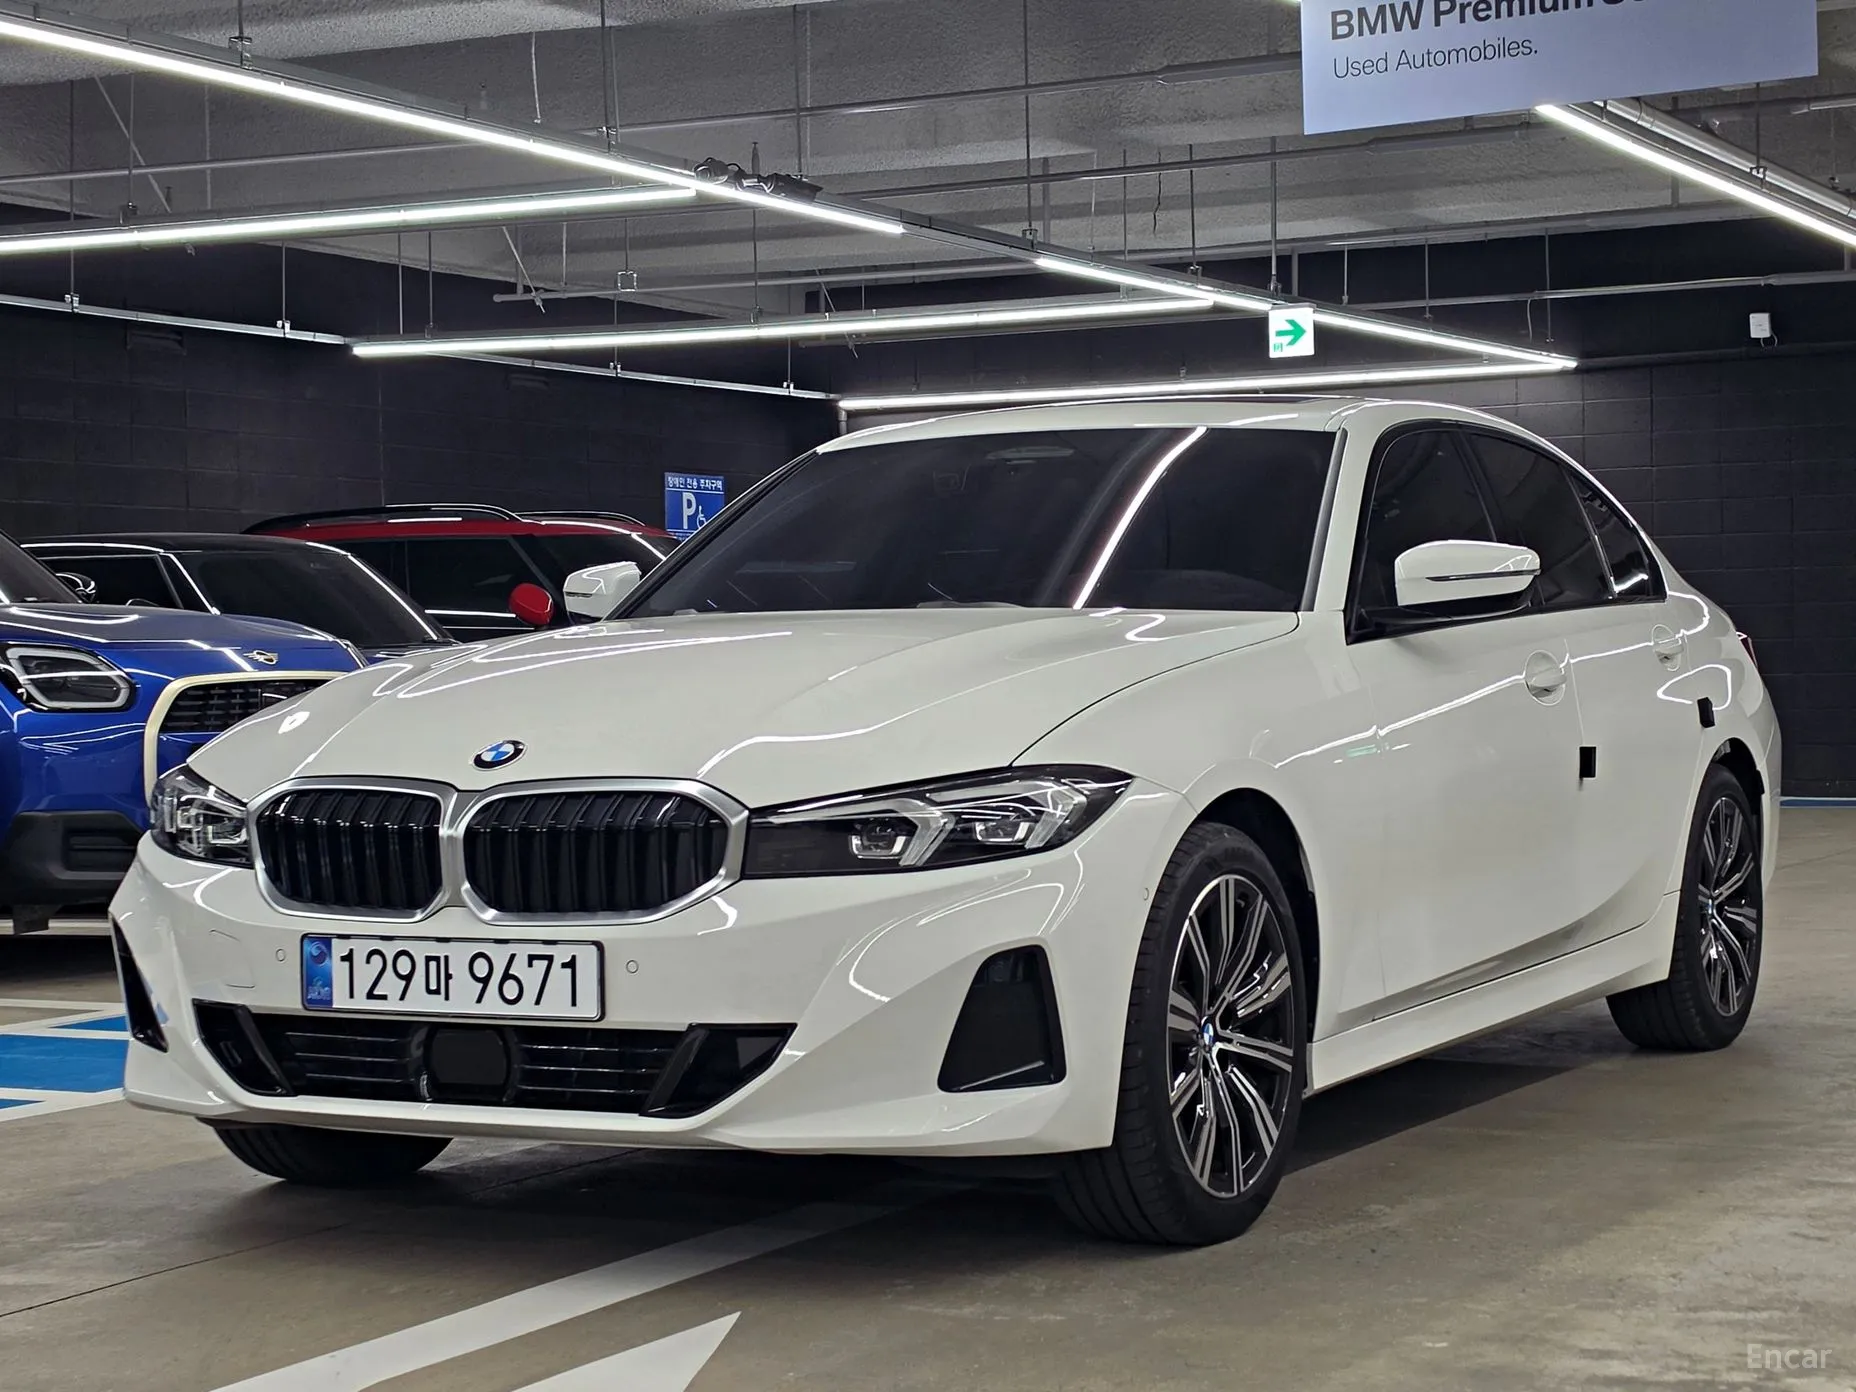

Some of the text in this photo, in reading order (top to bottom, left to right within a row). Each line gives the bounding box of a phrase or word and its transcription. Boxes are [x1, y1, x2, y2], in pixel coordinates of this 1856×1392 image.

[1330, 0, 1424, 40] BMW
[1333, 36, 1539, 79] Used Automobiles.
[667, 476, 723, 491] 장애인 전용 주차구역
[682, 491, 697, 530] P
[340, 947, 578, 1007] 129마 9671
